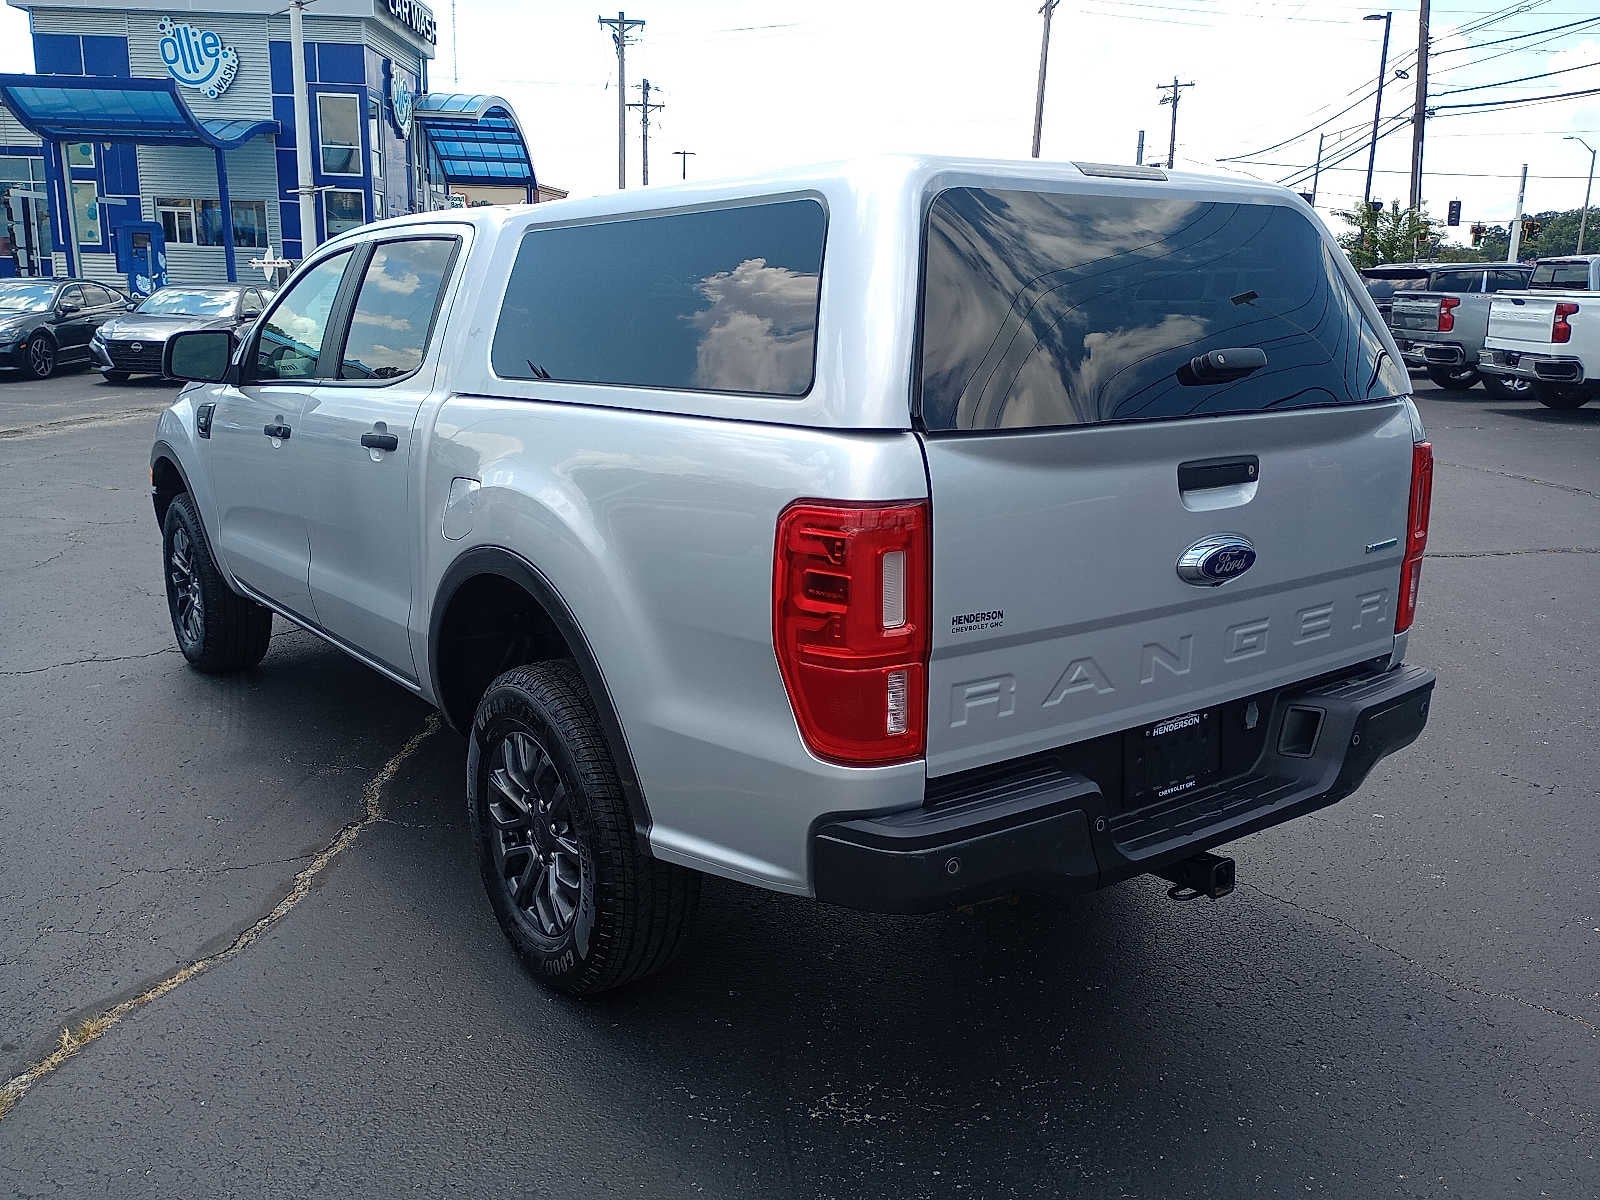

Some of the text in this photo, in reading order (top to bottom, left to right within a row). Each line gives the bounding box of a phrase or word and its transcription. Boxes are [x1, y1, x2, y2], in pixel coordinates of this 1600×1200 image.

[388, 0, 437, 45] CAR WASH
[160, 26, 220, 74] ollie
[213, 63, 237, 92] WASH
[1214, 549, 1247, 573] Ford
[951, 609, 1004, 626] HENDERSON
[951, 620, 1004, 634] CHEVROLET GMC
[948, 587, 1390, 729] RANGER
[1152, 715, 1200, 737] HENDERSON
